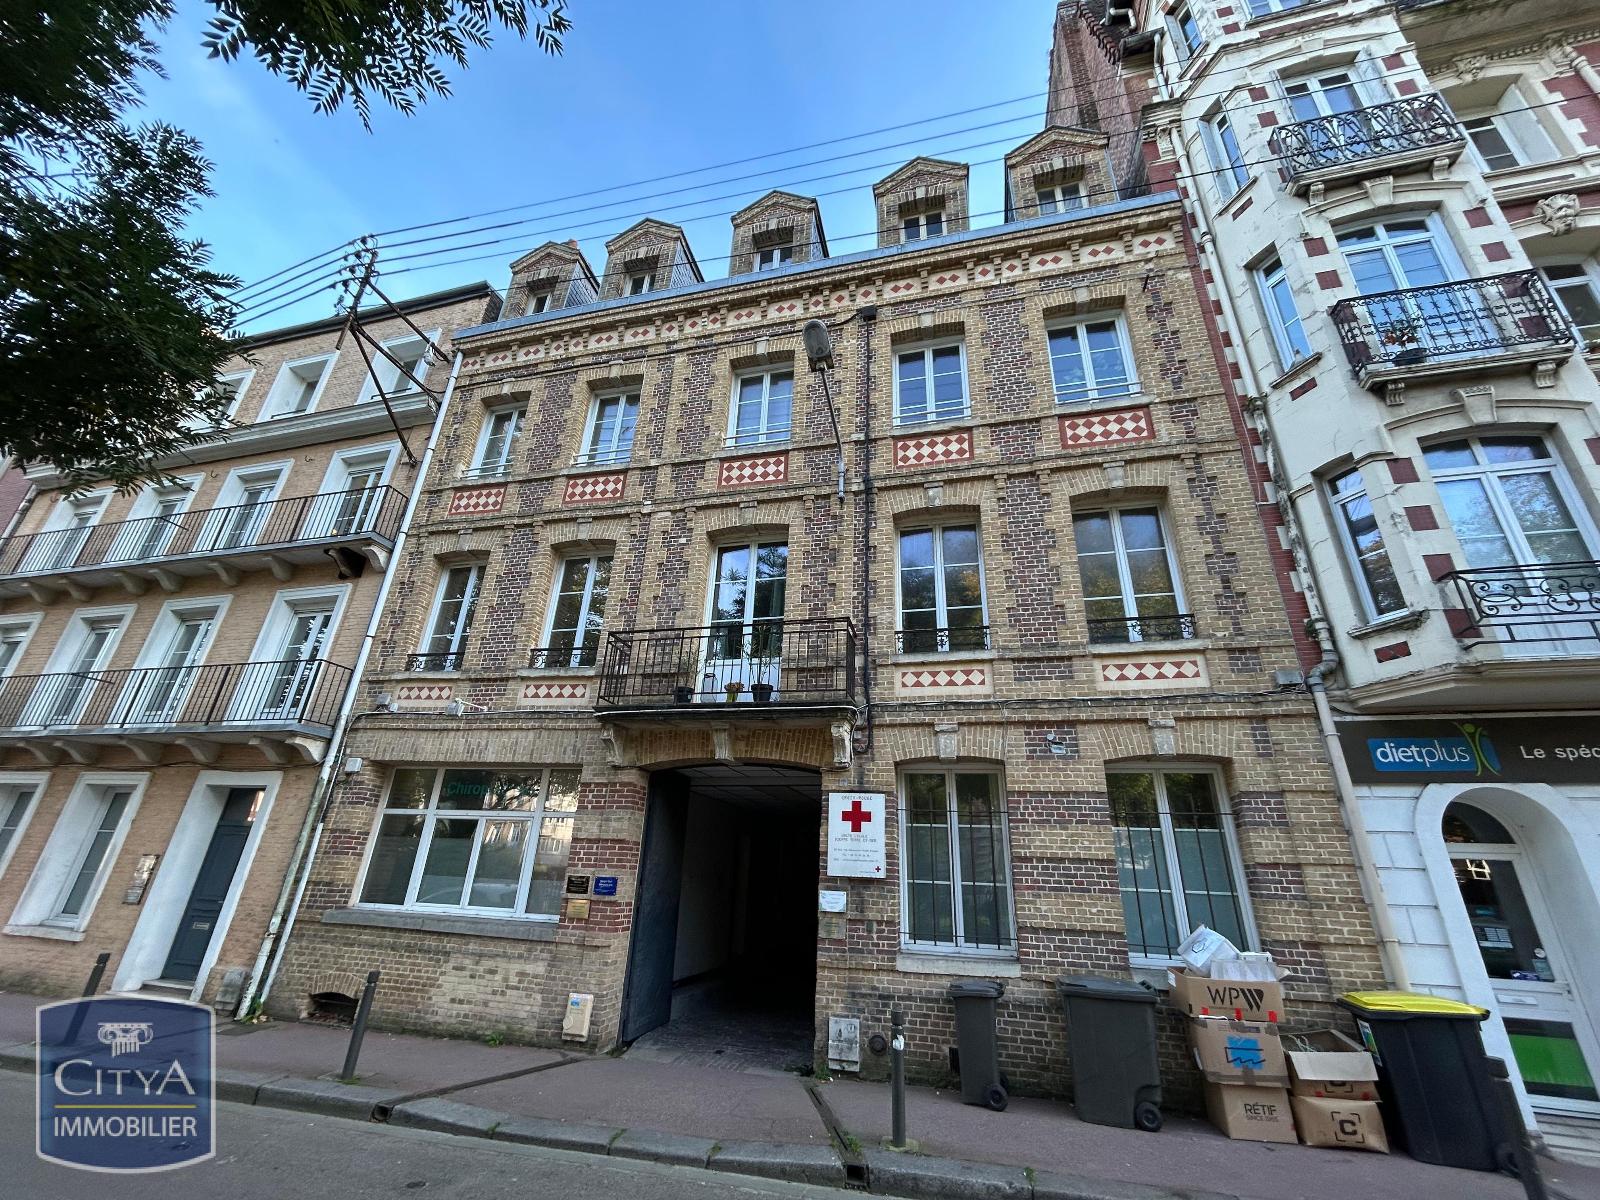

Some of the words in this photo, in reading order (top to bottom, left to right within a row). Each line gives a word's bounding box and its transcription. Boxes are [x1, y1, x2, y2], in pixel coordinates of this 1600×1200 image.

[1376, 741, 1470, 767] dietplus
[1520, 745, 1546, 759] Le
[1244, 1102, 1277, 1116] RÉTIF
[1338, 1119, 1358, 1136] C
